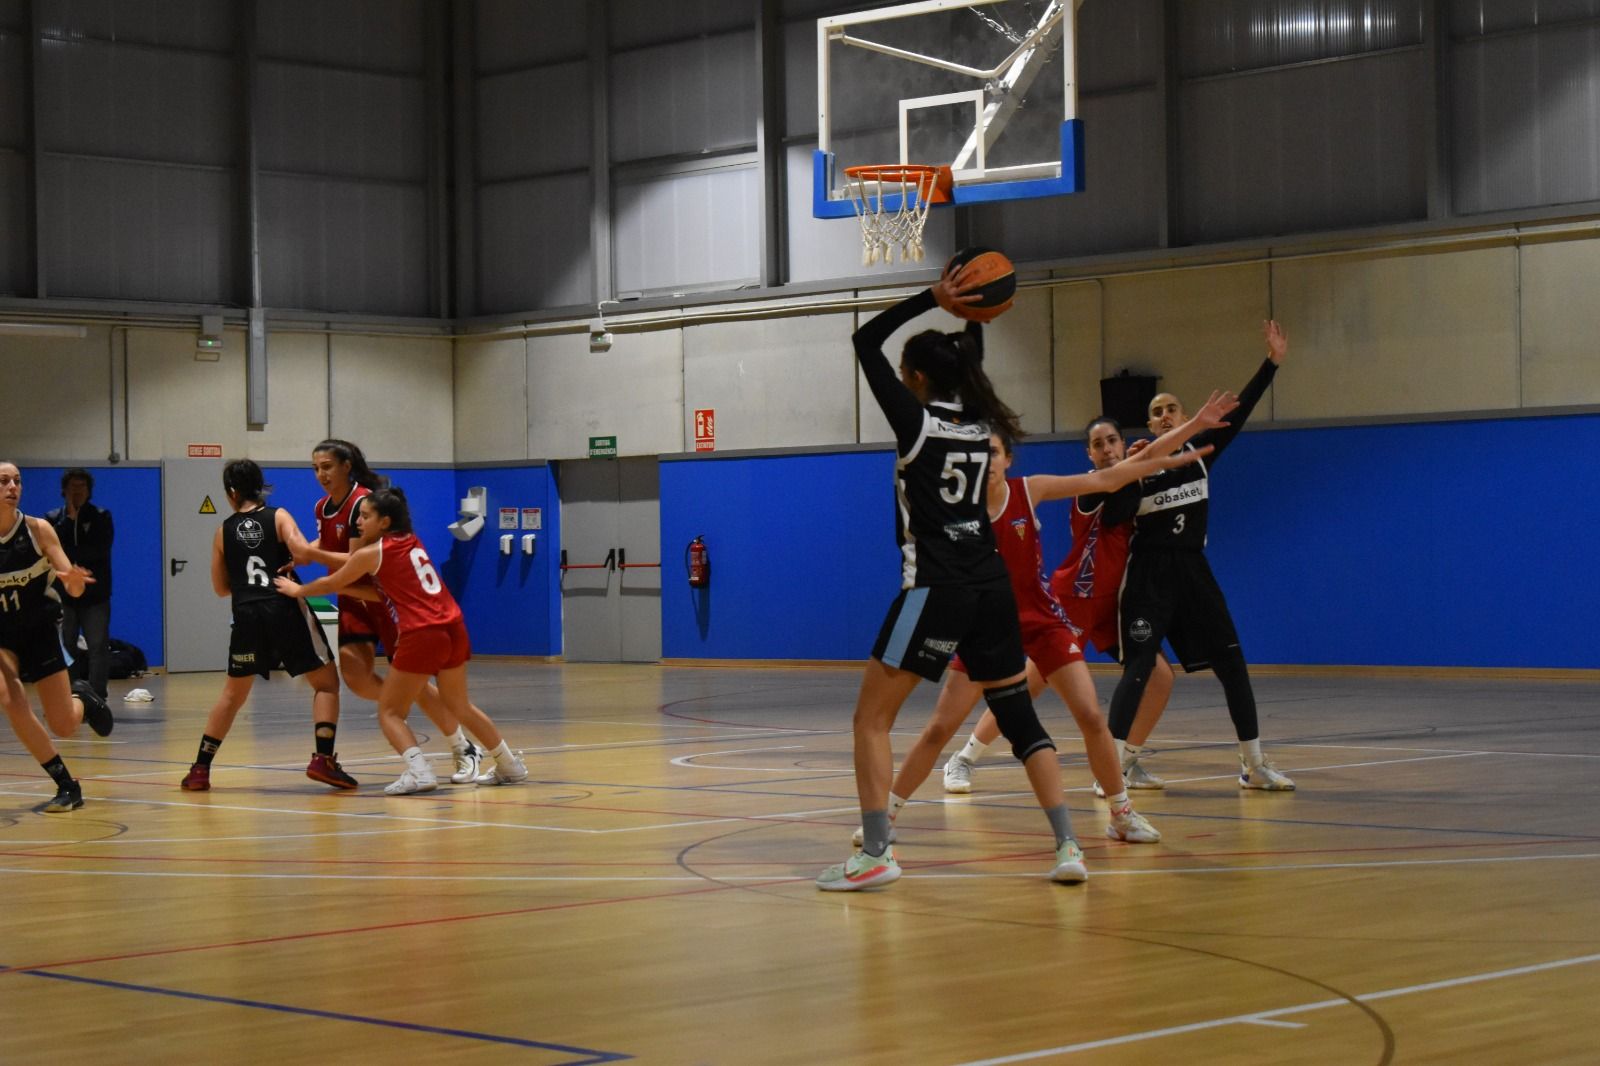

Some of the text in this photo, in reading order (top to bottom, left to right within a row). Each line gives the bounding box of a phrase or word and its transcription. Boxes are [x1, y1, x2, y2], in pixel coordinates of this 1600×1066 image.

[939, 451, 989, 505] 57
[1153, 487, 1202, 505] Qbasket
[1172, 513, 1186, 535] 3
[246, 555, 270, 587] 6
[409, 547, 442, 595] 6
[0, 590, 21, 612] 11
